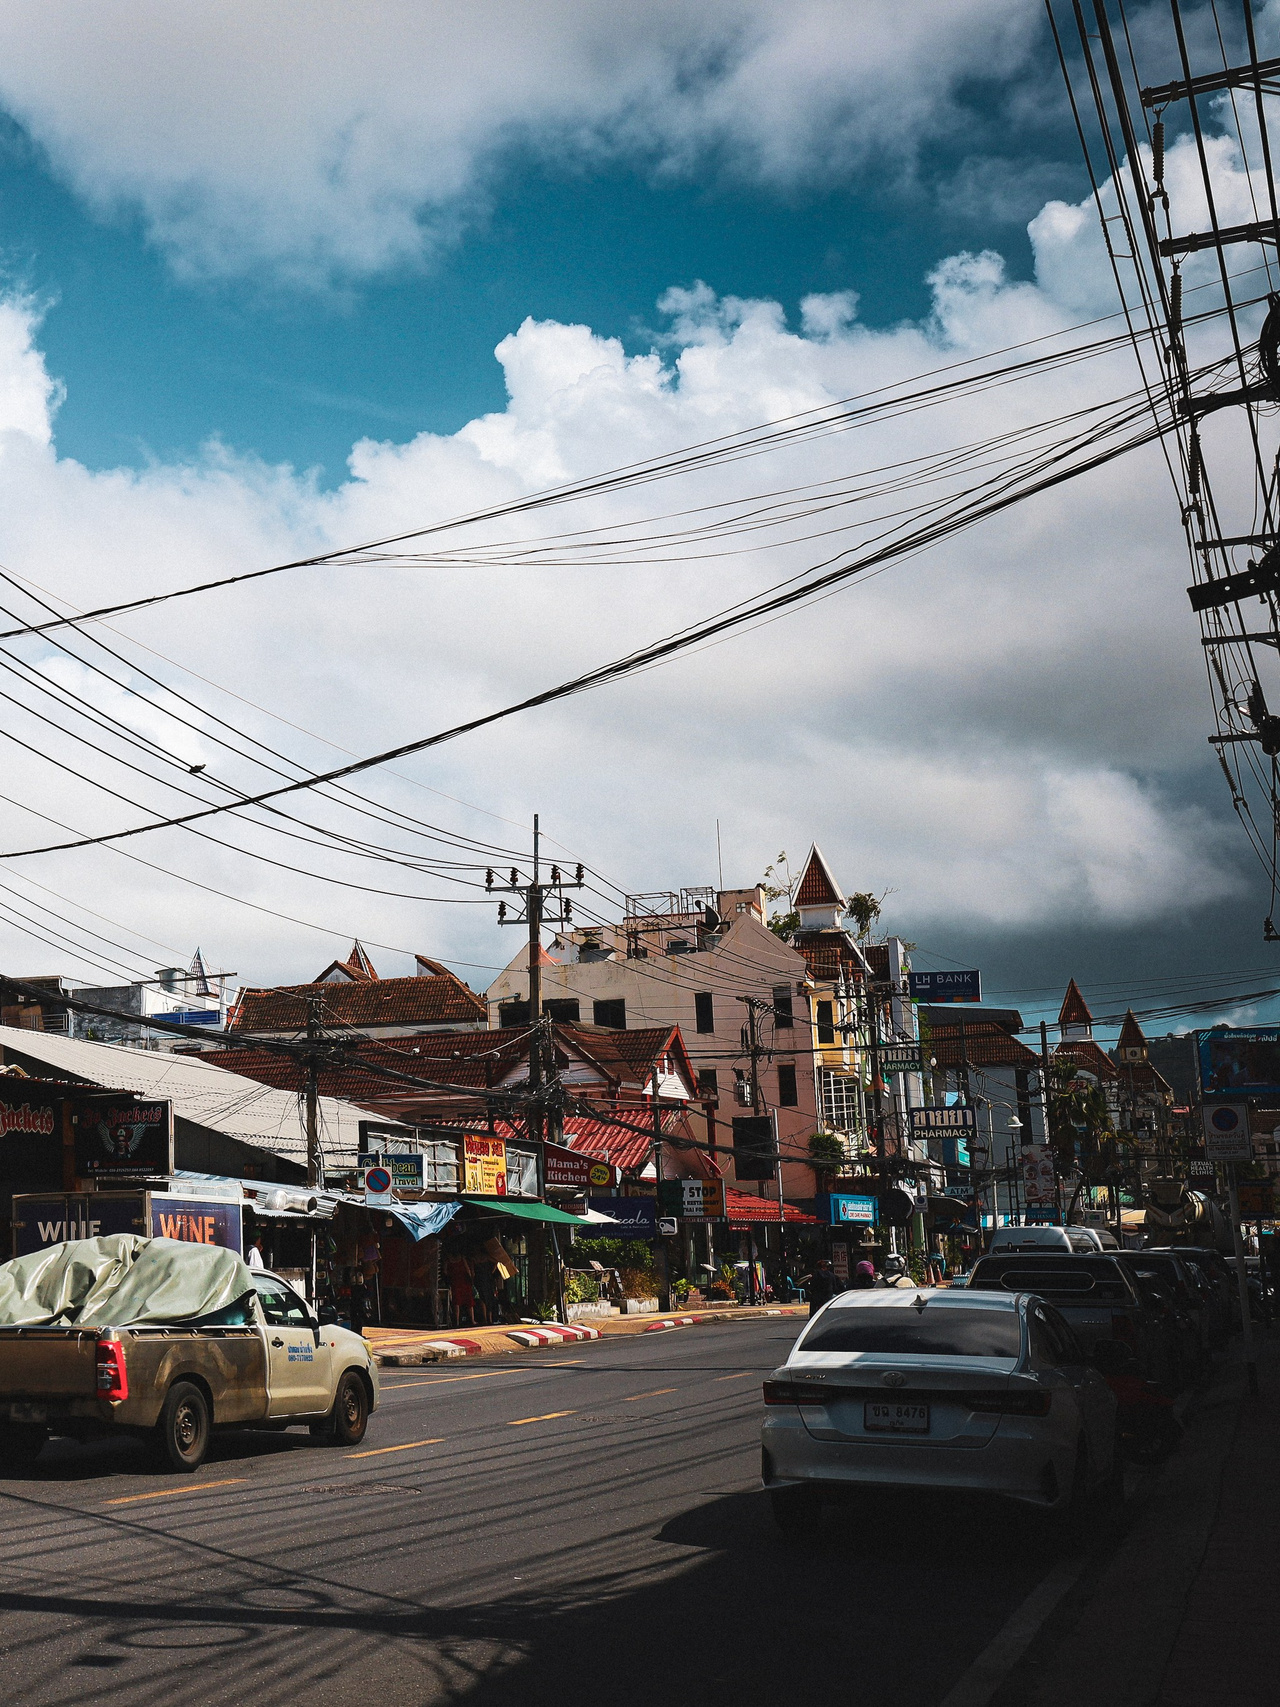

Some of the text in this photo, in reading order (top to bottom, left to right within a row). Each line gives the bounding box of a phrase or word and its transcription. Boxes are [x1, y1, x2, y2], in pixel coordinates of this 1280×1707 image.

[915, 973, 972, 984] LH BANK
[882, 1062, 920, 1070] HARMACY
[913, 1109, 973, 1127] ขายยา
[914, 1127, 974, 1139] PHARMACY
[547, 1157, 589, 1170] Mama's
[547, 1170, 588, 1182] Kitchen
[593, 1167, 608, 1177] OPEN
[393, 1177, 418, 1186] Travel
[688, 1186, 716, 1198] STOP
[949, 1187, 969, 1195] ATM
[600, 1210, 650, 1229] Pccola
[37, 1220, 102, 1242] WINE
[159, 1213, 216, 1246] WINE
[895, 1406, 926, 1419] 8476
